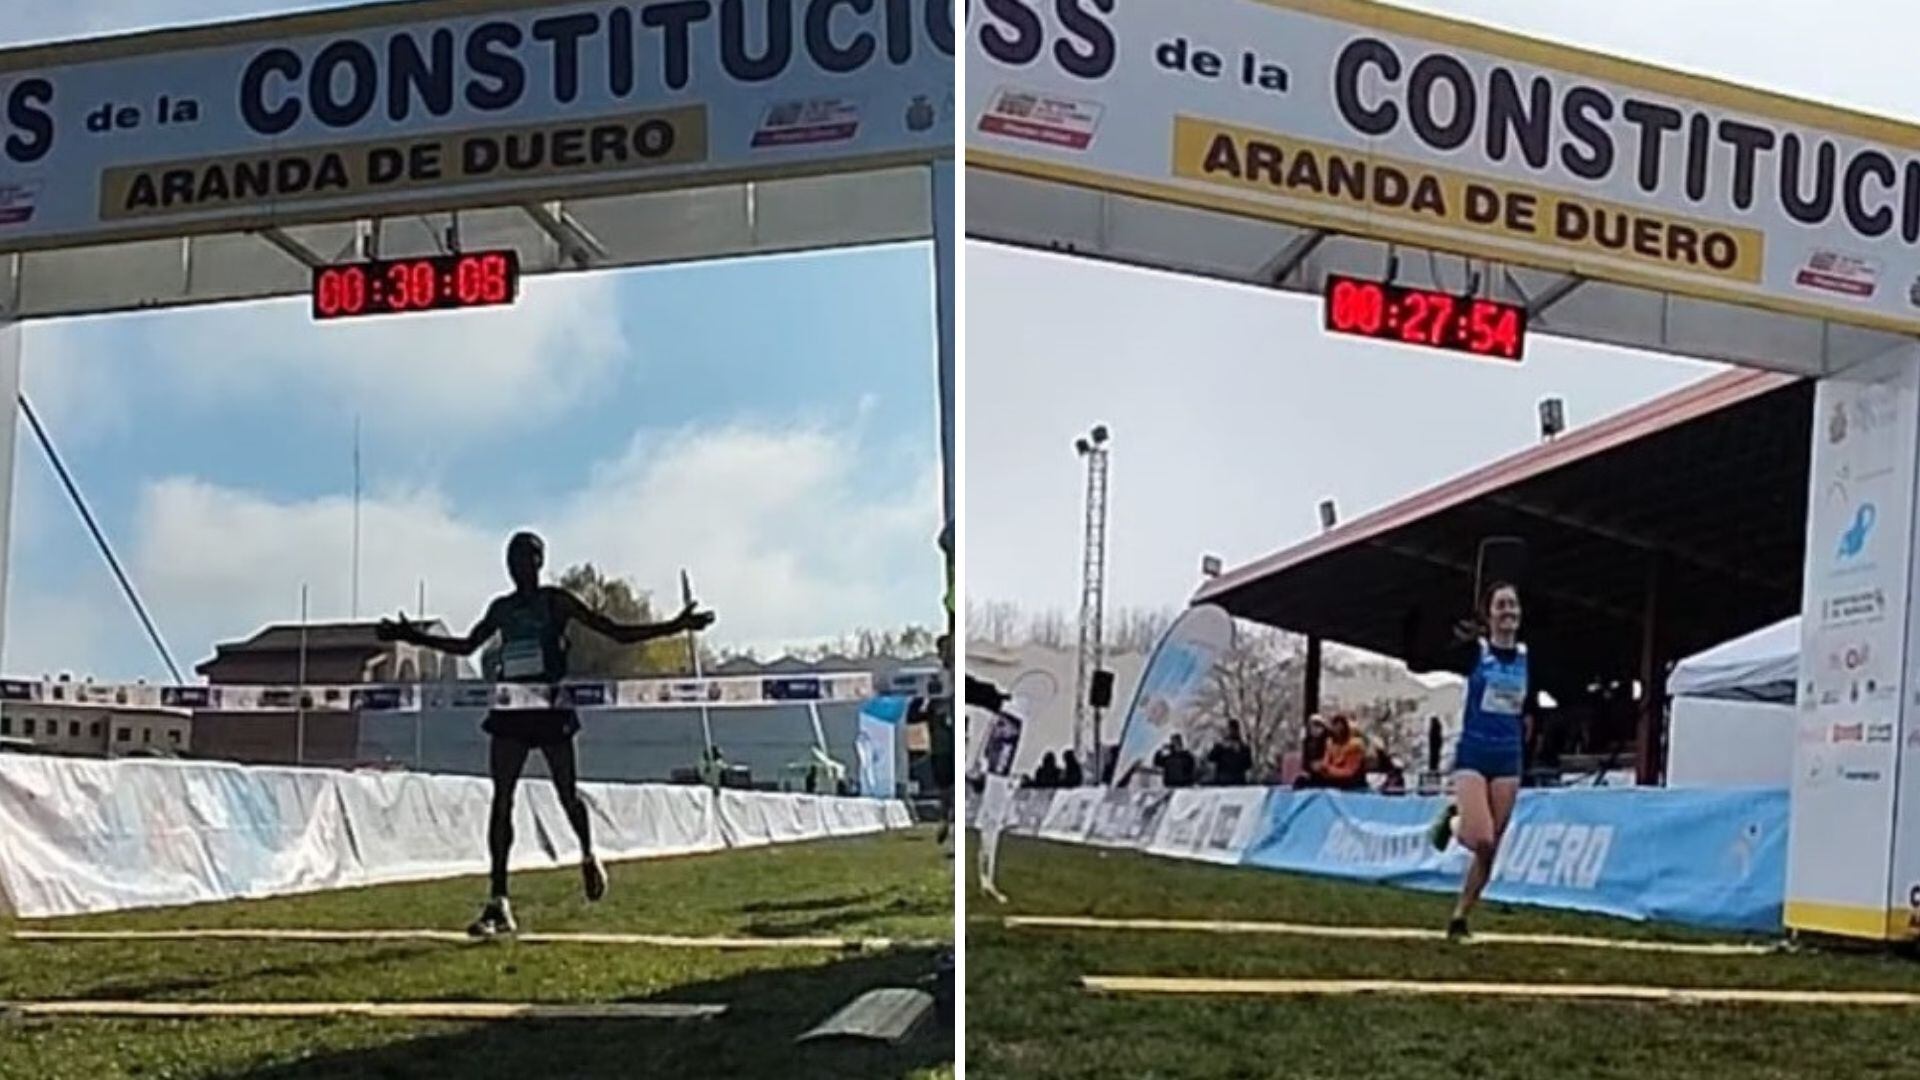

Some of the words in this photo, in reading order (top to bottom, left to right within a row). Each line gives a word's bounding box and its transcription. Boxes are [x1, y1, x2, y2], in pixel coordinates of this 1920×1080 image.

[965, 0, 1116, 78] SS
[1156, 38, 1222, 77] de
[1242, 52, 1289, 92] la
[86, 104, 141, 133] de
[158, 96, 199, 124] la
[125, 154, 349, 211] ARANDA
[367, 143, 442, 184] DE
[462, 118, 676, 174] DUERO
[1203, 133, 1447, 217] ARANDA
[1464, 185, 1538, 232] DE
[1556, 203, 1738, 270] DUERO
[1332, 281, 1518, 356] 00:27:54
